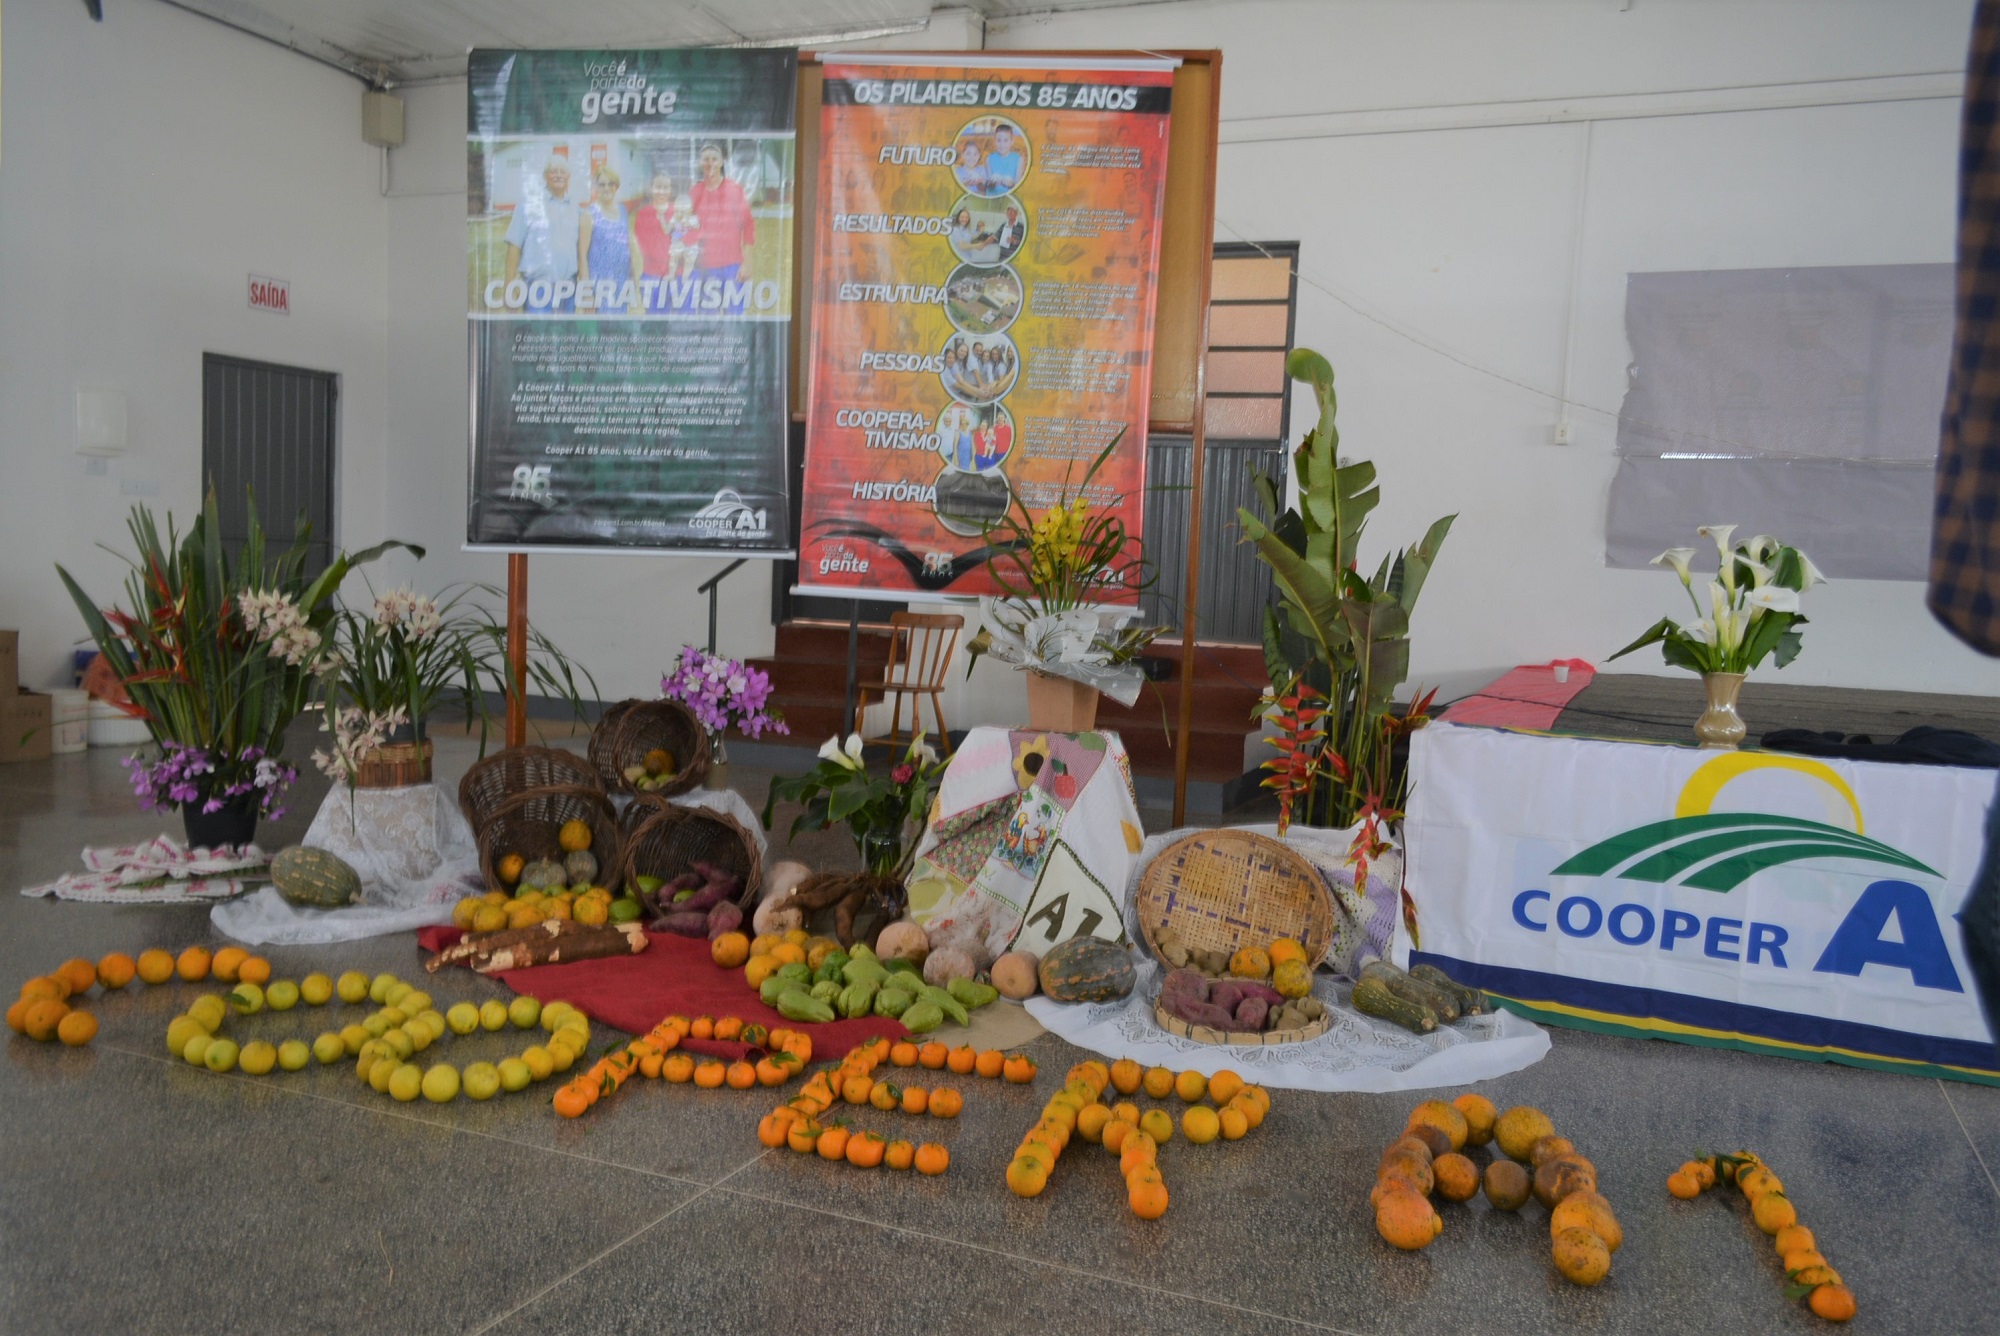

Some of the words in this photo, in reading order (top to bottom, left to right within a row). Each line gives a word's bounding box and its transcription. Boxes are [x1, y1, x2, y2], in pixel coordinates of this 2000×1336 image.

[584, 61, 616, 76] Você
[617, 59, 626, 75] é
[591, 75, 627, 92] parte
[627, 74, 646, 89] da
[582, 88, 677, 123] gente
[854, 84, 885, 105] OS
[888, 84, 977, 106] PILARES
[983, 85, 1031, 107] DOS
[1036, 86, 1068, 108] 85
[1071, 86, 1138, 111] ANOS
[878, 145, 957, 166] FUTURO
[832, 214, 954, 236] RESULTADOS
[251, 280, 288, 310] SAÍDA
[484, 278, 779, 312] COOPERATIVISMO
[839, 283, 949, 306] ESTRUTURA
[860, 352, 945, 373] PESSOAS
[518, 383, 524, 392] A
[526, 383, 553, 394] Cooper
[555, 383, 565, 392] A1
[568, 384, 595, 395] respira
[597, 384, 657, 395] cooperativismo
[659, 384, 682, 393] desde
[700, 384, 740, 396] fundação.
[511, 394, 521, 402] Ao
[522, 394, 548, 405] juntar
[549, 394, 573, 405] forças
[582, 396, 613, 406] pessoas
[629, 395, 652, 404] busca
[654, 395, 664, 404] de
[679, 395, 713, 407] objetivo
[715, 398, 747, 407] comum,
[515, 404, 527, 413] ela
[529, 406, 555, 415] supera
[558, 404, 602, 416] obstáculos,
[604, 405, 641, 414] sobrevive
[658, 405, 688, 417] tempos
[689, 406, 699, 414] de
[701, 406, 722, 417] crise,
[724, 408, 743, 417] gera
[517, 414, 541, 425] renda,
[544, 415, 560, 423] leva
[562, 415, 599, 426] educação
[608, 415, 623, 424] tem
[640, 416, 659, 424] sério
[661, 416, 715, 427] compromisso
[835, 409, 932, 430] COOPERA-
[574, 425, 640, 435] desenvolvimento
[643, 426, 653, 435] da
[655, 426, 682, 437] região.
[864, 430, 942, 451] TIVISMO
[545, 446, 574, 457] Cooper
[575, 446, 585, 455] A1
[588, 446, 599, 455] 85
[600, 449, 621, 458] anos,
[624, 447, 641, 456] você
[643, 447, 648, 456] é
[650, 447, 672, 458] parte
[674, 447, 684, 456] da
[686, 448, 711, 459] gente.
[511, 465, 552, 494] 85
[509, 493, 552, 501] ANOS
[851, 480, 938, 502] HISTÓRIA
[688, 519, 732, 529] COOPER
[735, 508, 766, 530] A1
[819, 557, 869, 575] gente
[922, 552, 953, 573] 85
[1511, 889, 1790, 969] COOPER
[1812, 880, 1965, 994] A
